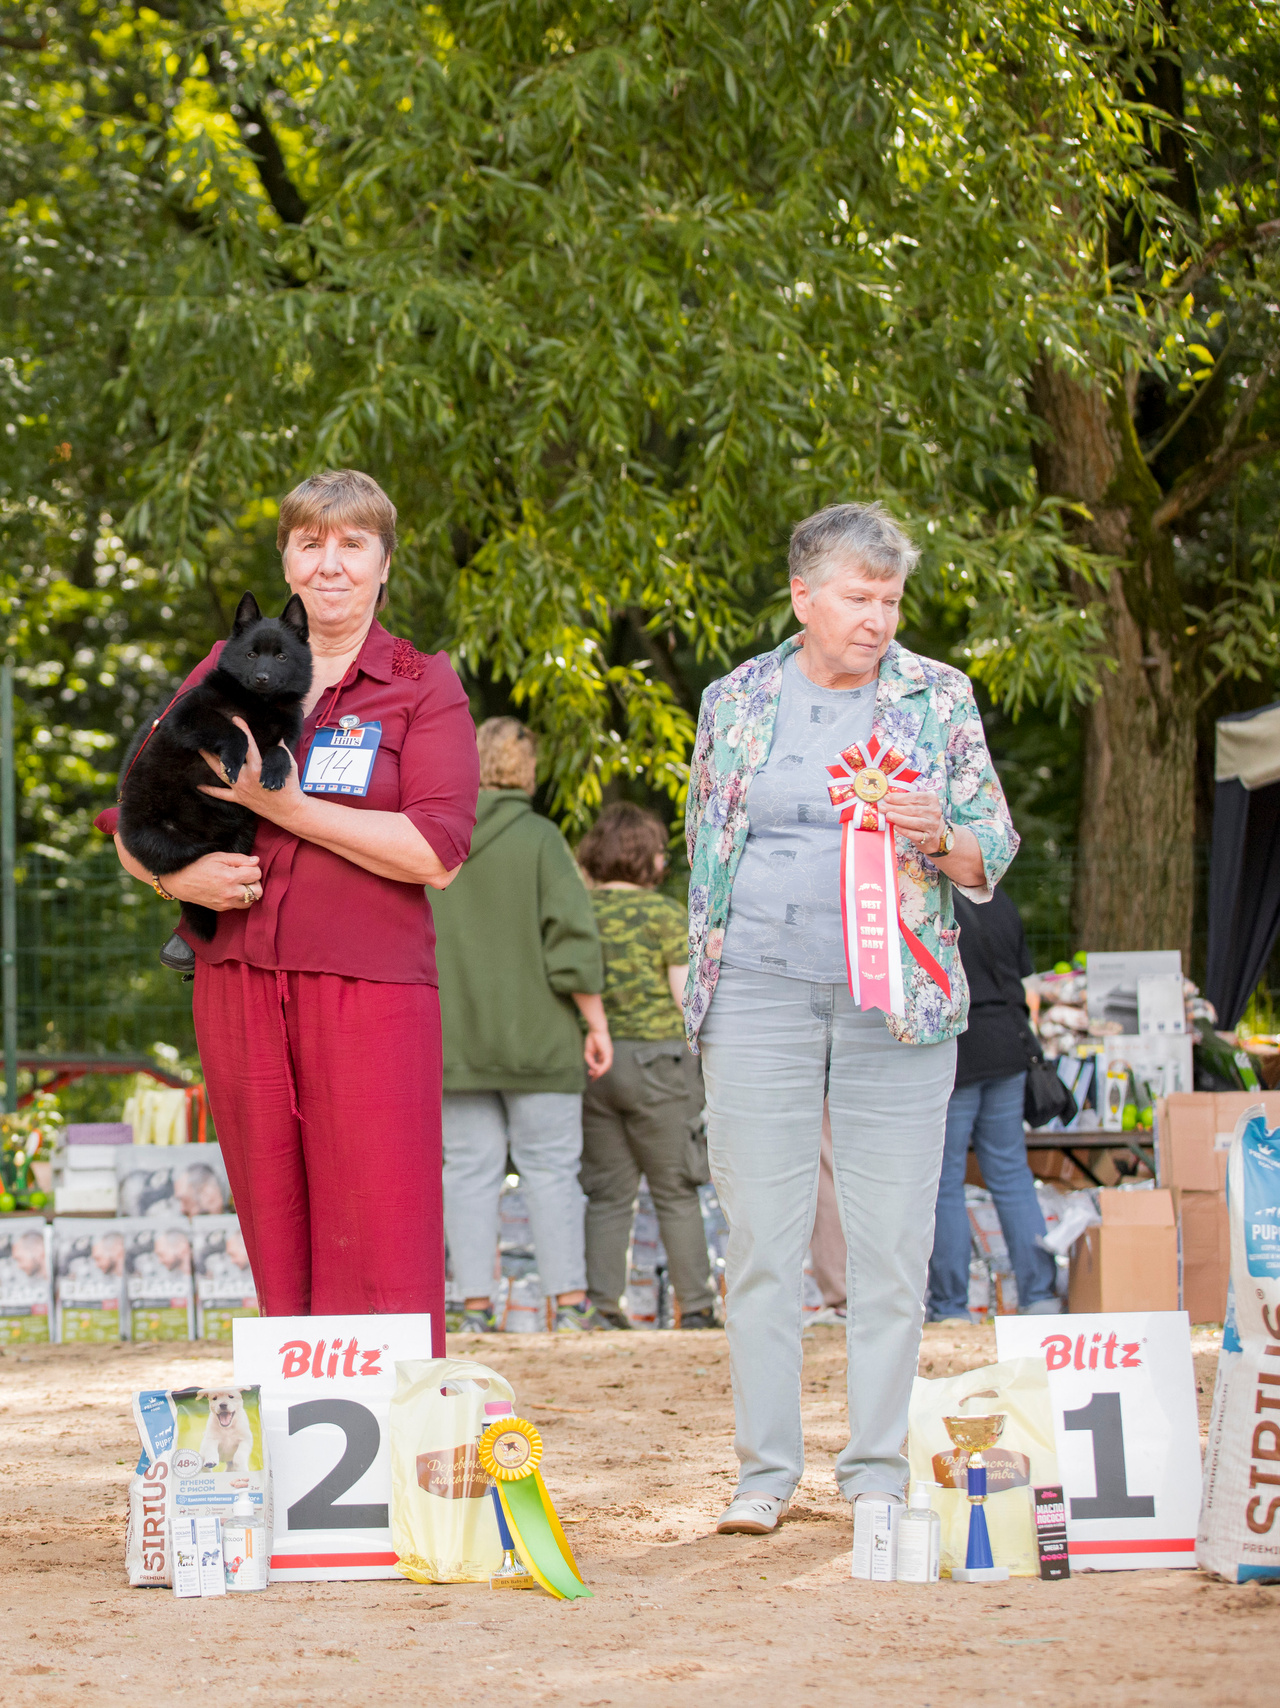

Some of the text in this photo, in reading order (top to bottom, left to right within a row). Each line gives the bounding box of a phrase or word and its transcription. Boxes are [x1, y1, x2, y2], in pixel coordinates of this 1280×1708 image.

[333, 737, 360, 746] Hill's
[317, 750, 353, 781] 14
[861, 900, 881, 909] BEST
[867, 913, 876, 922] IN
[860, 926, 884, 936] SHOW
[861, 940, 884, 949] BABY
[871, 955, 875, 963] I
[1040, 1331, 1143, 1371] Blitz
[278, 1337, 383, 1379] Blitz
[1063, 1392, 1155, 1519] 1
[177, 1459, 197, 1468] 48%
[287, 1398, 389, 1530] 2
[945, 1468, 1016, 1480] лакства
[1036, 1503, 1064, 1514] МАСЛО
[142, 1461, 169, 1572] SIRIUS
[1037, 1513, 1065, 1524] ЛОСОСЯ
